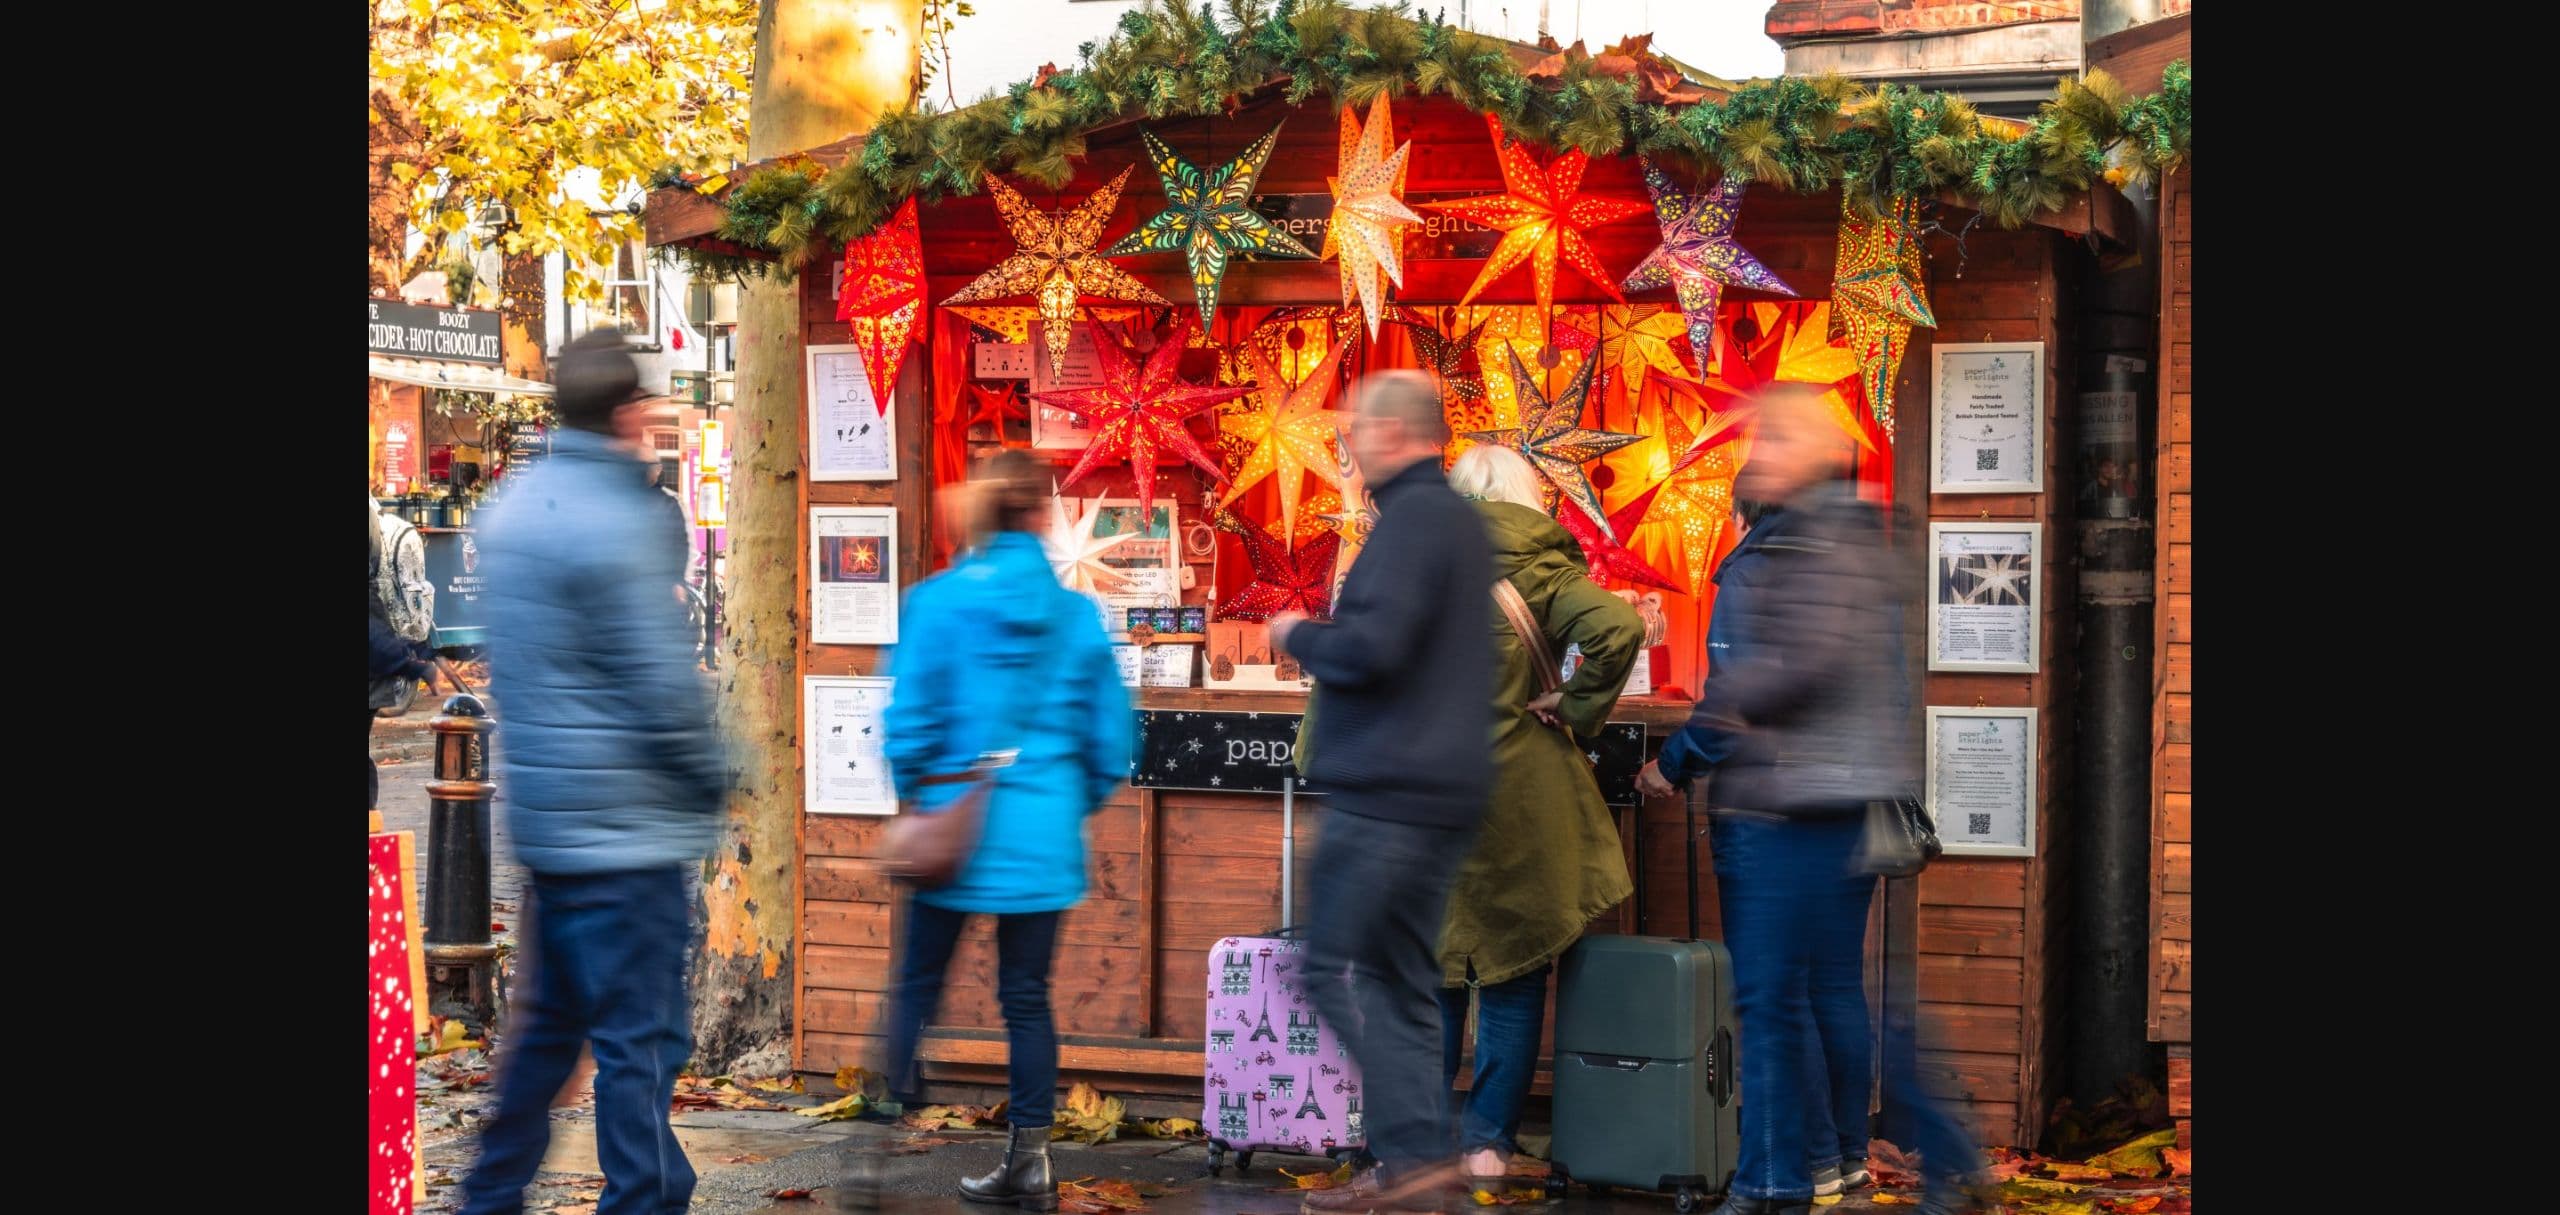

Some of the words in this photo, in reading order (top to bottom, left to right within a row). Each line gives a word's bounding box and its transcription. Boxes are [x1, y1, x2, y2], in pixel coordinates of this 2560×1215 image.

[439, 311, 470, 329] BOOZY
[409, 328, 433, 352] HOT
[435, 330, 499, 358] CHOCOLATE
[1236, 1009, 1252, 1028] Paris
[1319, 1063, 1341, 1077] Paris
[1269, 1106, 1288, 1121] Paris
